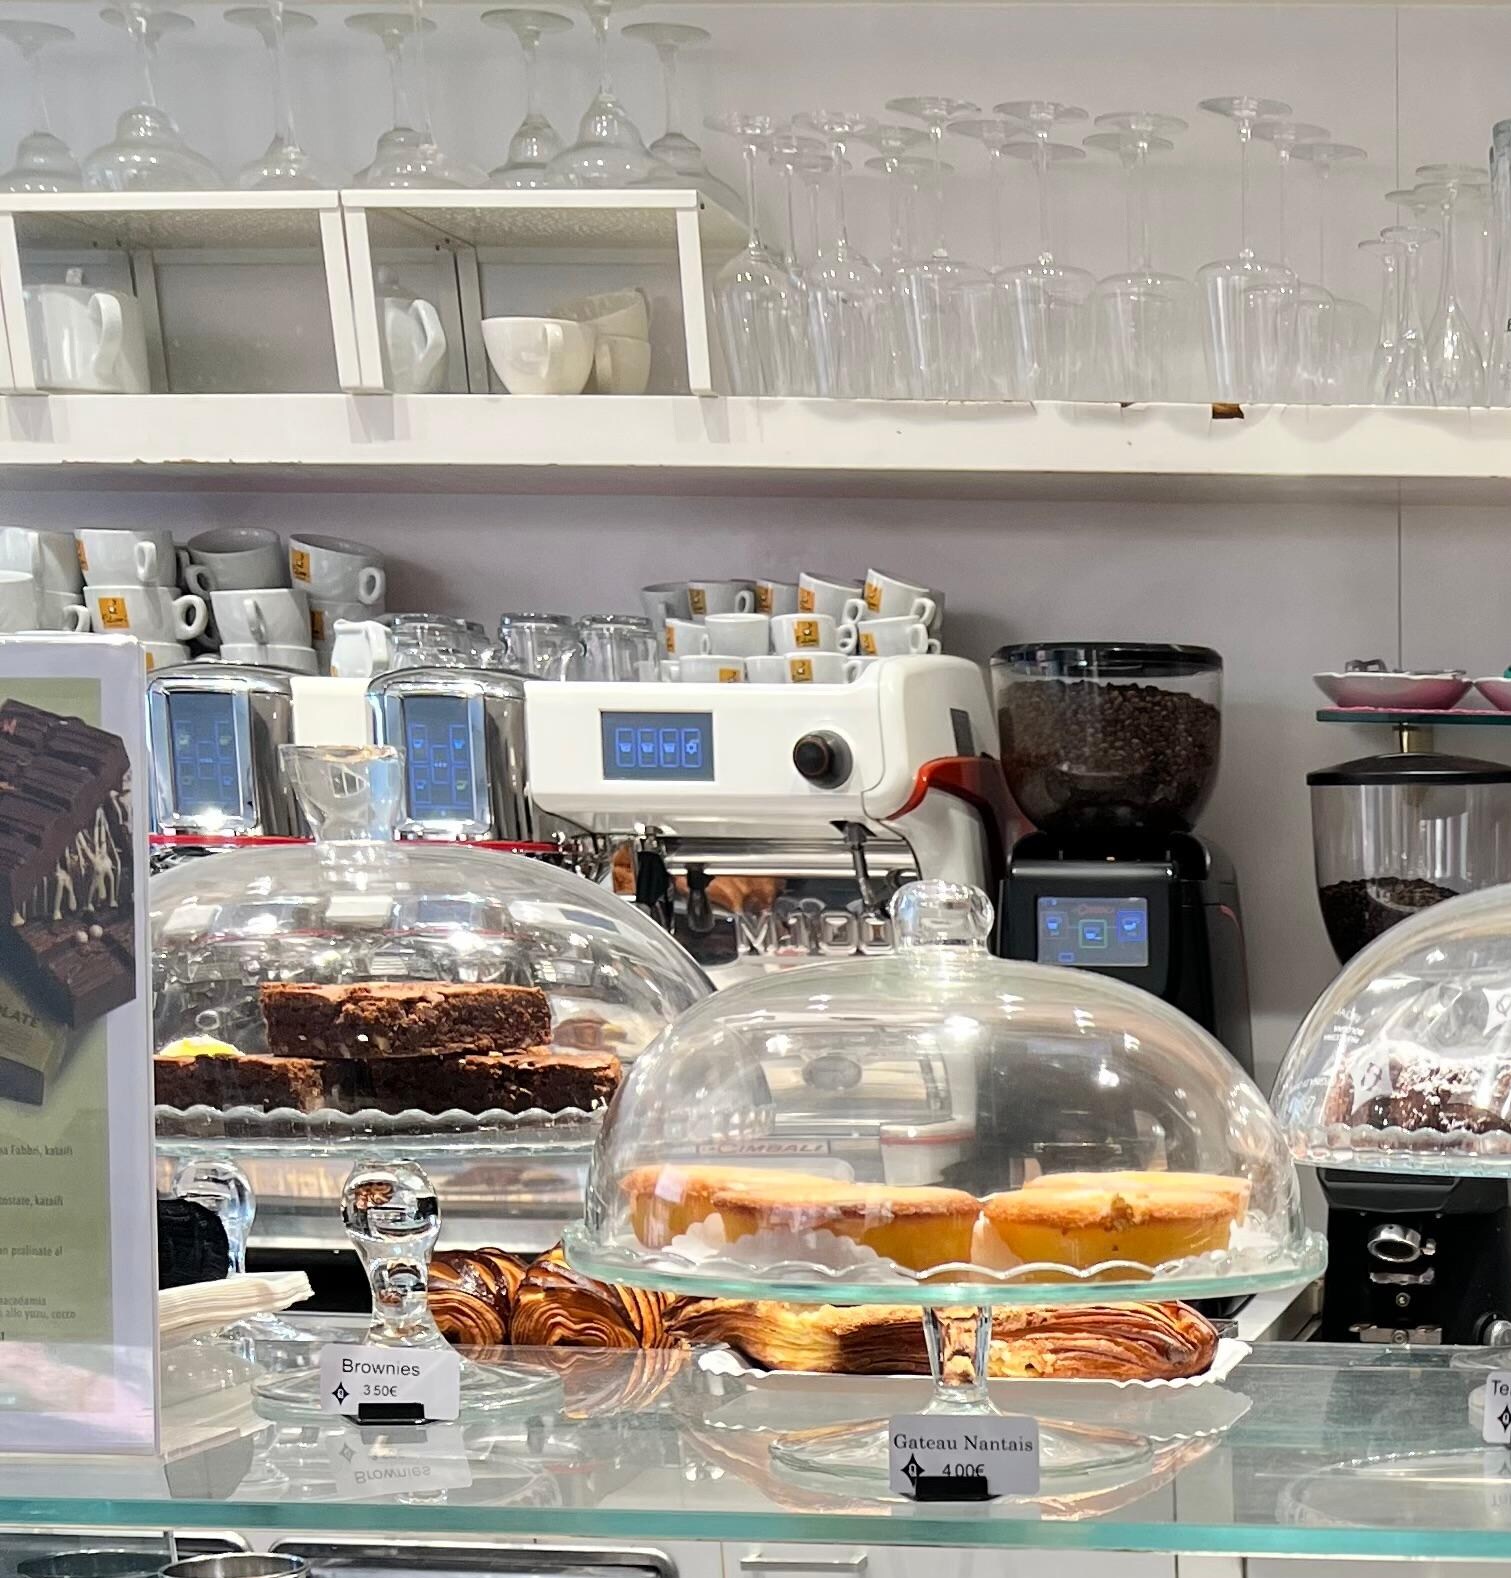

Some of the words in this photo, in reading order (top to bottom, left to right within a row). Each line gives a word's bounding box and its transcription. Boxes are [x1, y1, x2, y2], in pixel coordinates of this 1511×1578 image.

[341, 1358, 421, 1377] Brownies
[893, 1433, 958, 1451] Gateau
[964, 1434, 1034, 1453] Nantais
